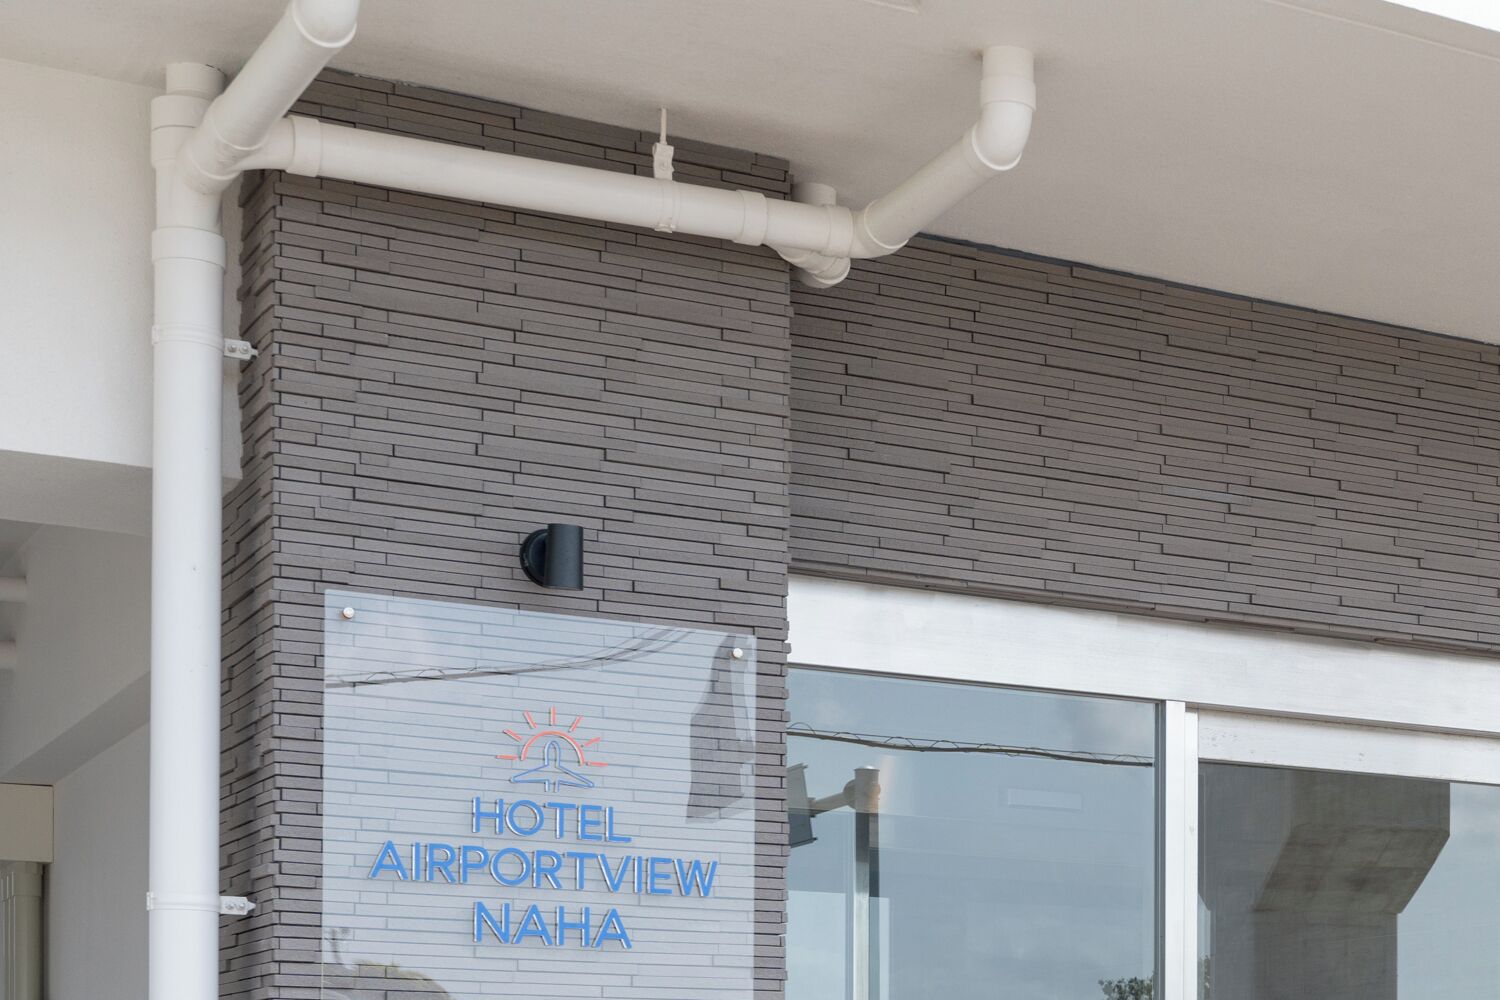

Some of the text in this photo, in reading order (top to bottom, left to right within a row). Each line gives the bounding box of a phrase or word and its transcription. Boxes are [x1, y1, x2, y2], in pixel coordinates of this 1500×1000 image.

[472, 796, 633, 843] HOTEL
[368, 840, 718, 897] AIRPORTVIEW
[473, 901, 633, 949] NAHA
